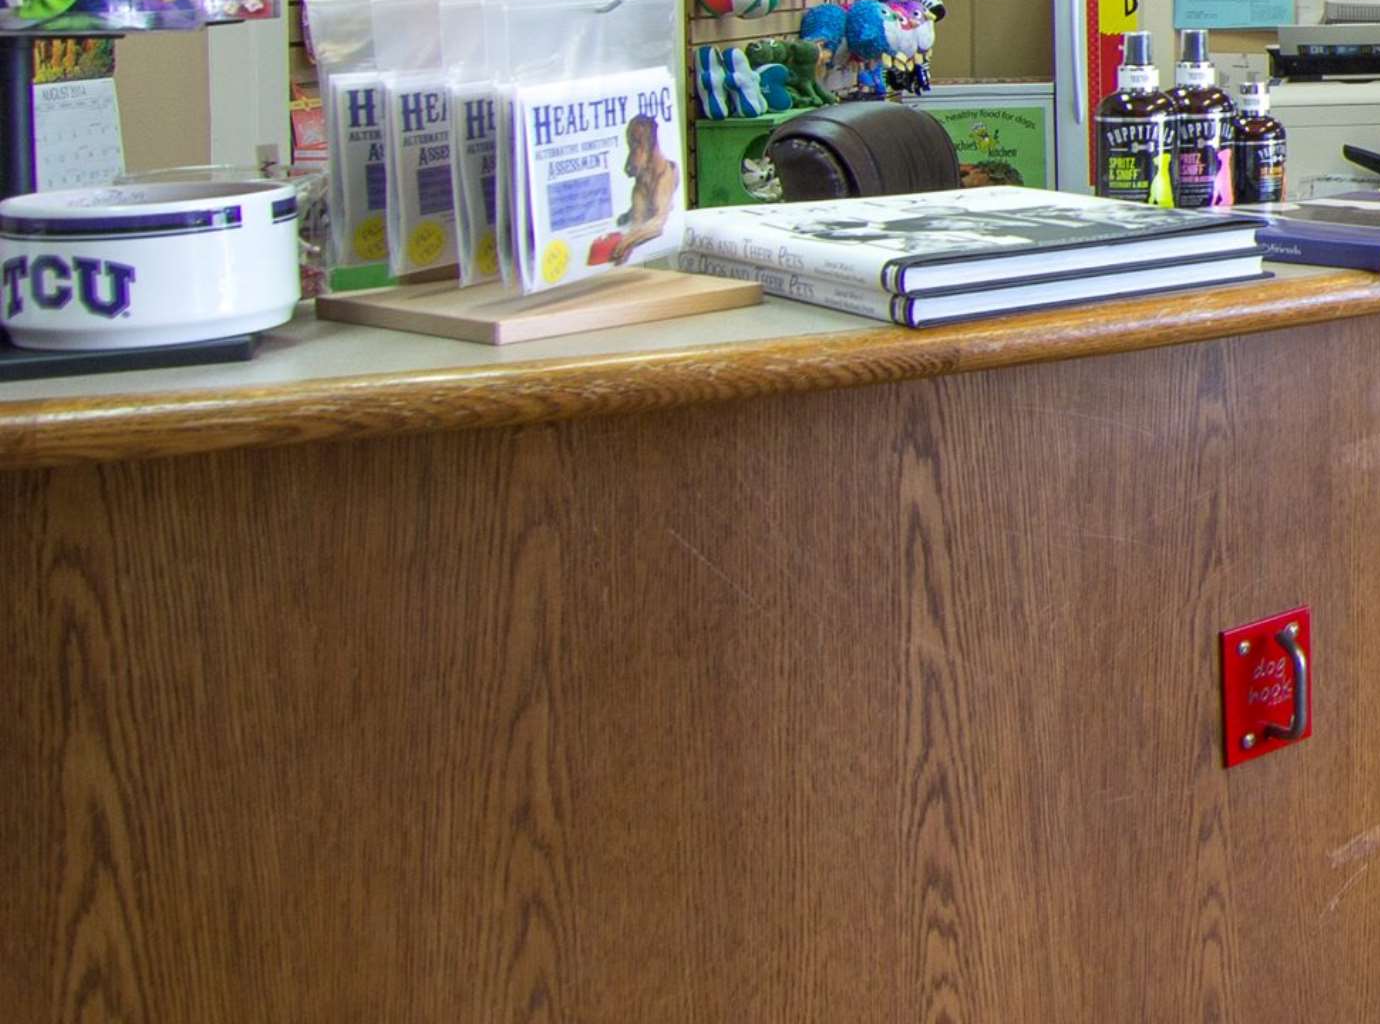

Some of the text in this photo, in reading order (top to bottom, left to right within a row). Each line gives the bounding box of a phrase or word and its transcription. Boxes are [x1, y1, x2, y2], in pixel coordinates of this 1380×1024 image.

[531, 95, 628, 146] HEALTHY
[637, 87, 673, 123] DOG
[547, 150, 611, 181] ASSESSMENT
[2, 253, 137, 320] TCU
